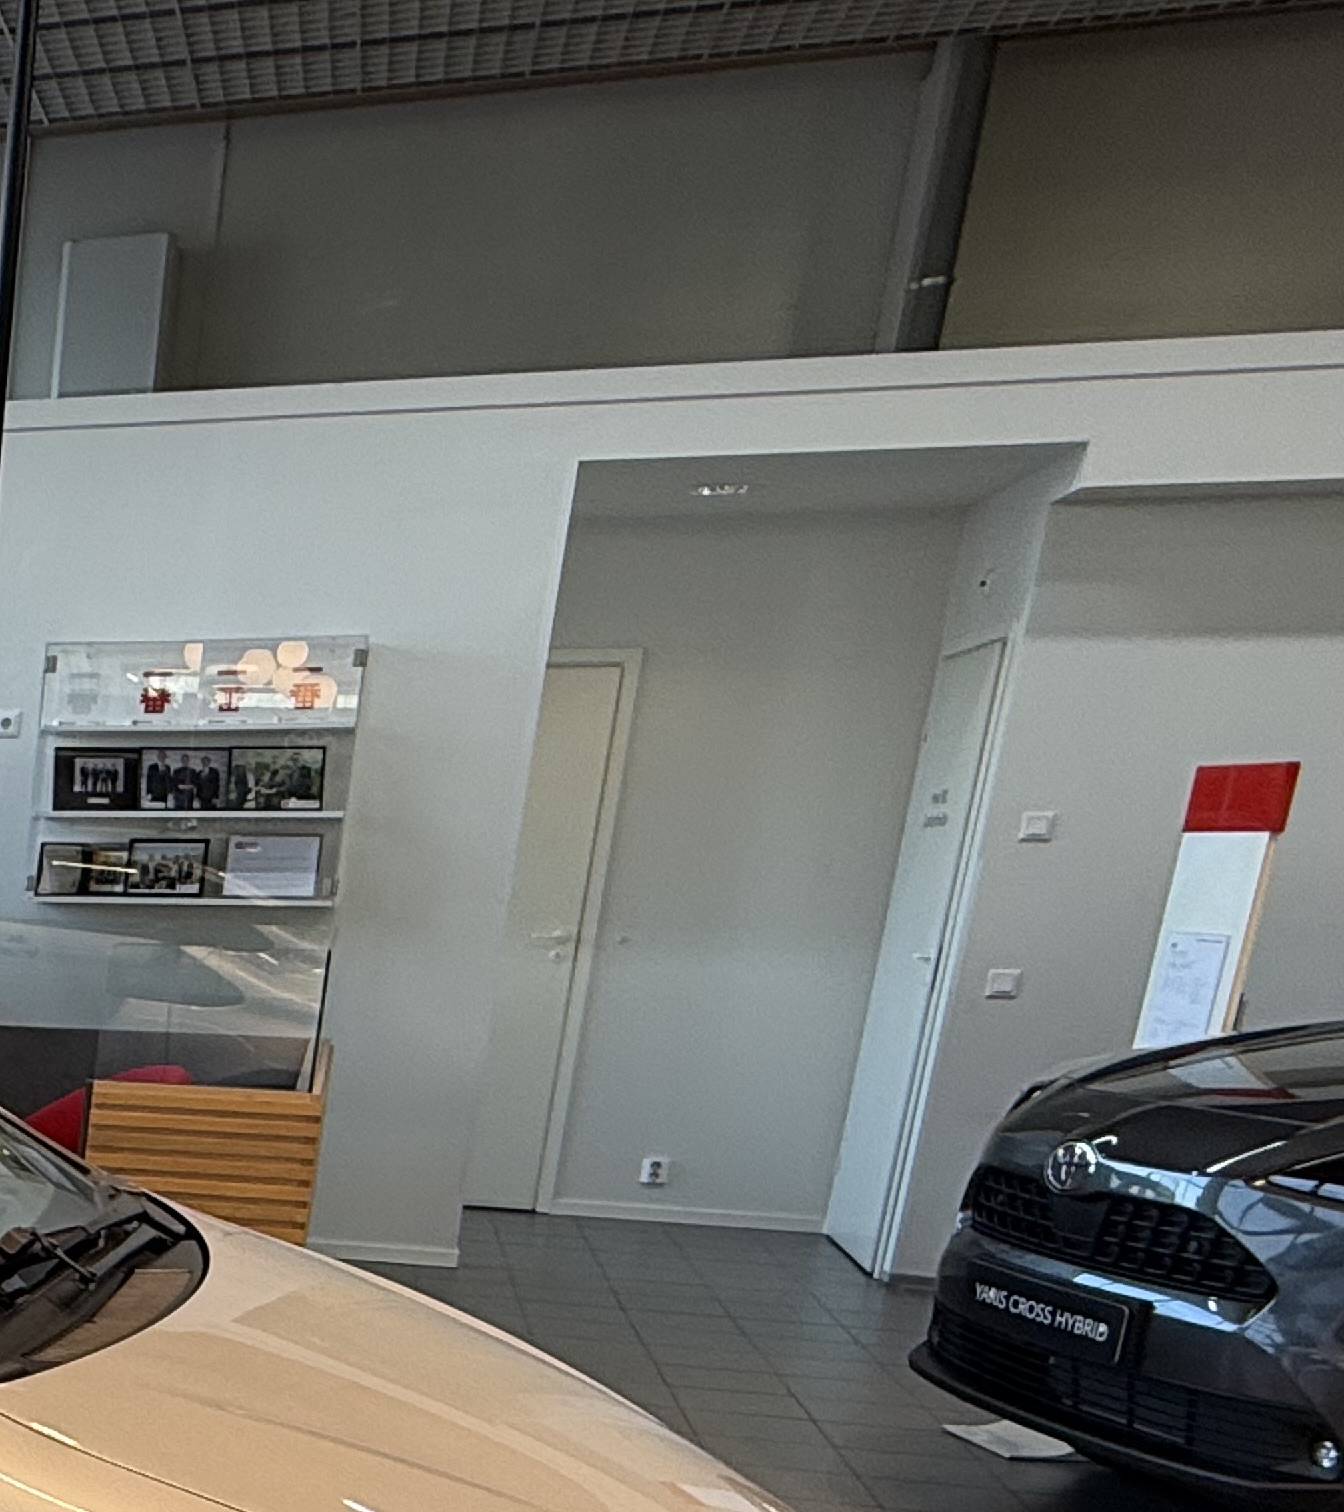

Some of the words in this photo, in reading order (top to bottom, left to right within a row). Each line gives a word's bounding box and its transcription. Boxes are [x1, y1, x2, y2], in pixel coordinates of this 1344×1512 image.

[975, 1282, 1008, 1309] YARIS
[1009, 1295, 1053, 1325] CROSS
[1054, 1309, 1109, 1342] HYBRID
